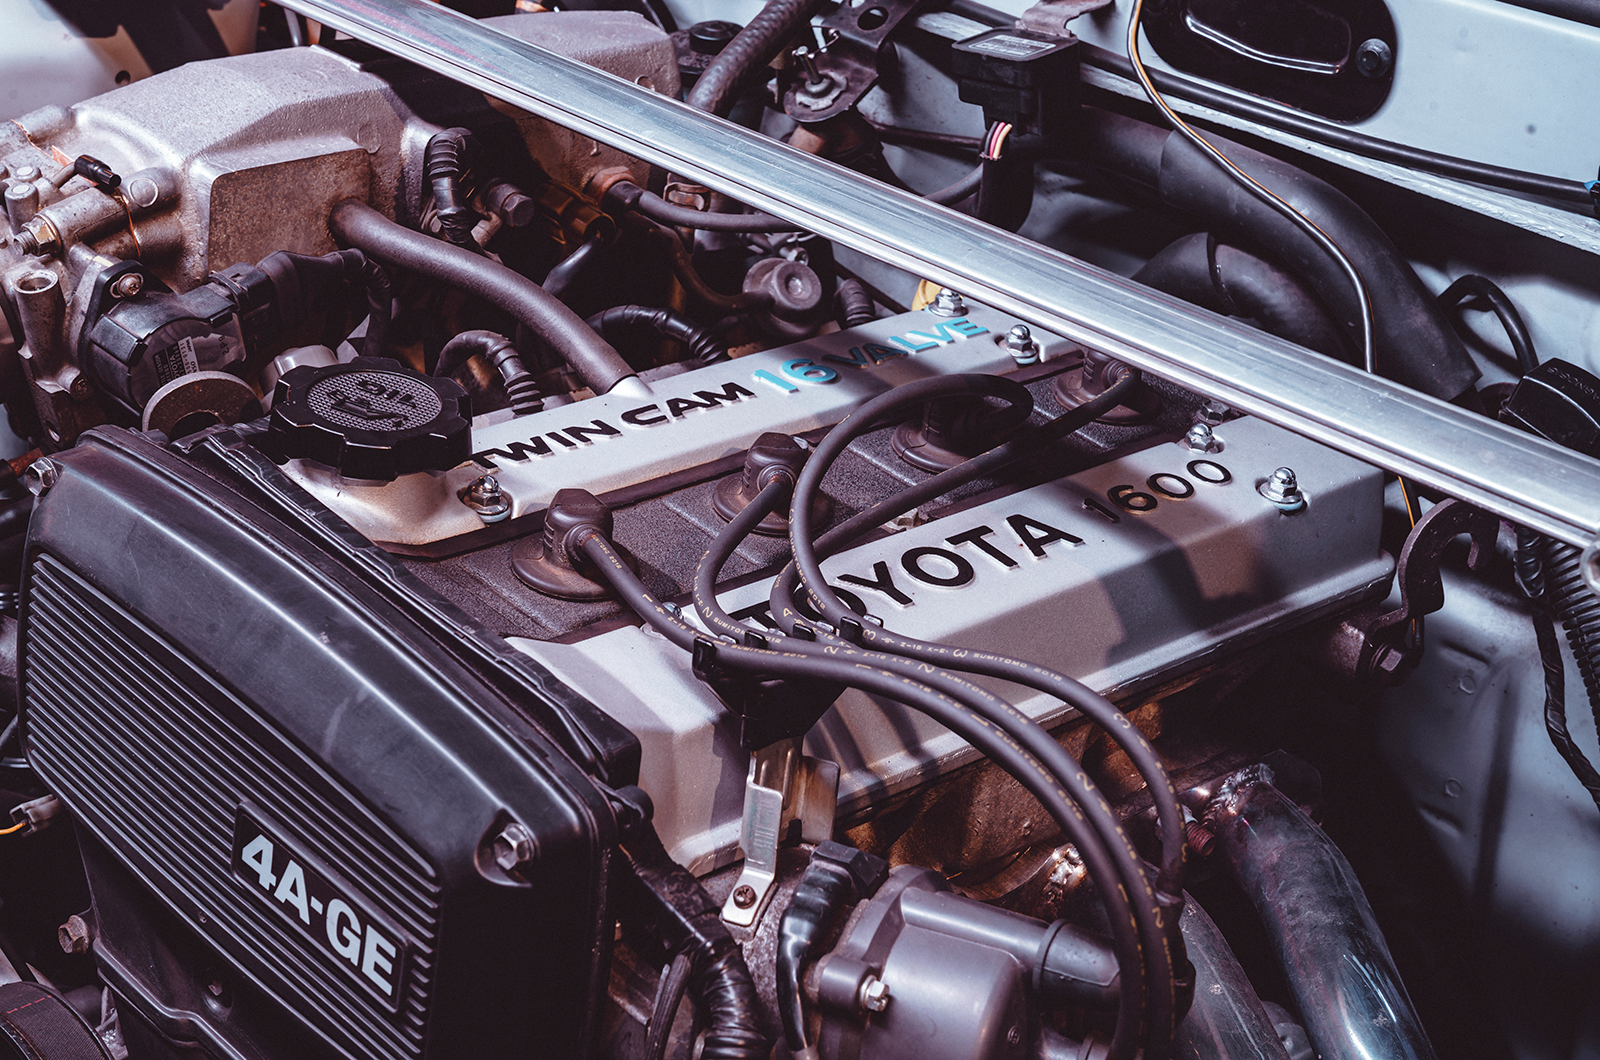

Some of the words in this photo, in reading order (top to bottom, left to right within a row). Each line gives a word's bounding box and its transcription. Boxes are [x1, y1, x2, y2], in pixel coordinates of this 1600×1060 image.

[169, 354, 181, 379] OYOTA
[357, 380, 417, 409] OIL
[470, 419, 622, 470] TWIN
[621, 381, 757, 424] CAM
[752, 357, 838, 395] 16
[823, 317, 989, 370] VALVE
[726, 513, 1085, 628] TOYOTA
[1081, 458, 1233, 525] 1600
[783, 607, 793, 617] 4
[702, 606, 714, 619] 2
[713, 617, 746, 635] SUMITOM
[765, 636, 782, 644] 012
[823, 645, 840, 655] 2
[917, 663, 936, 673] 2
[940, 671, 995, 702] SUMITOMO
[1076, 771, 1095, 791] 2
[863, 629, 877, 640] 3
[953, 648, 968, 658] 3
[973, 652, 1028, 669] SUMITOMO
[1113, 712, 1131, 729] 3
[241, 834, 397, 997] 4A-GE
